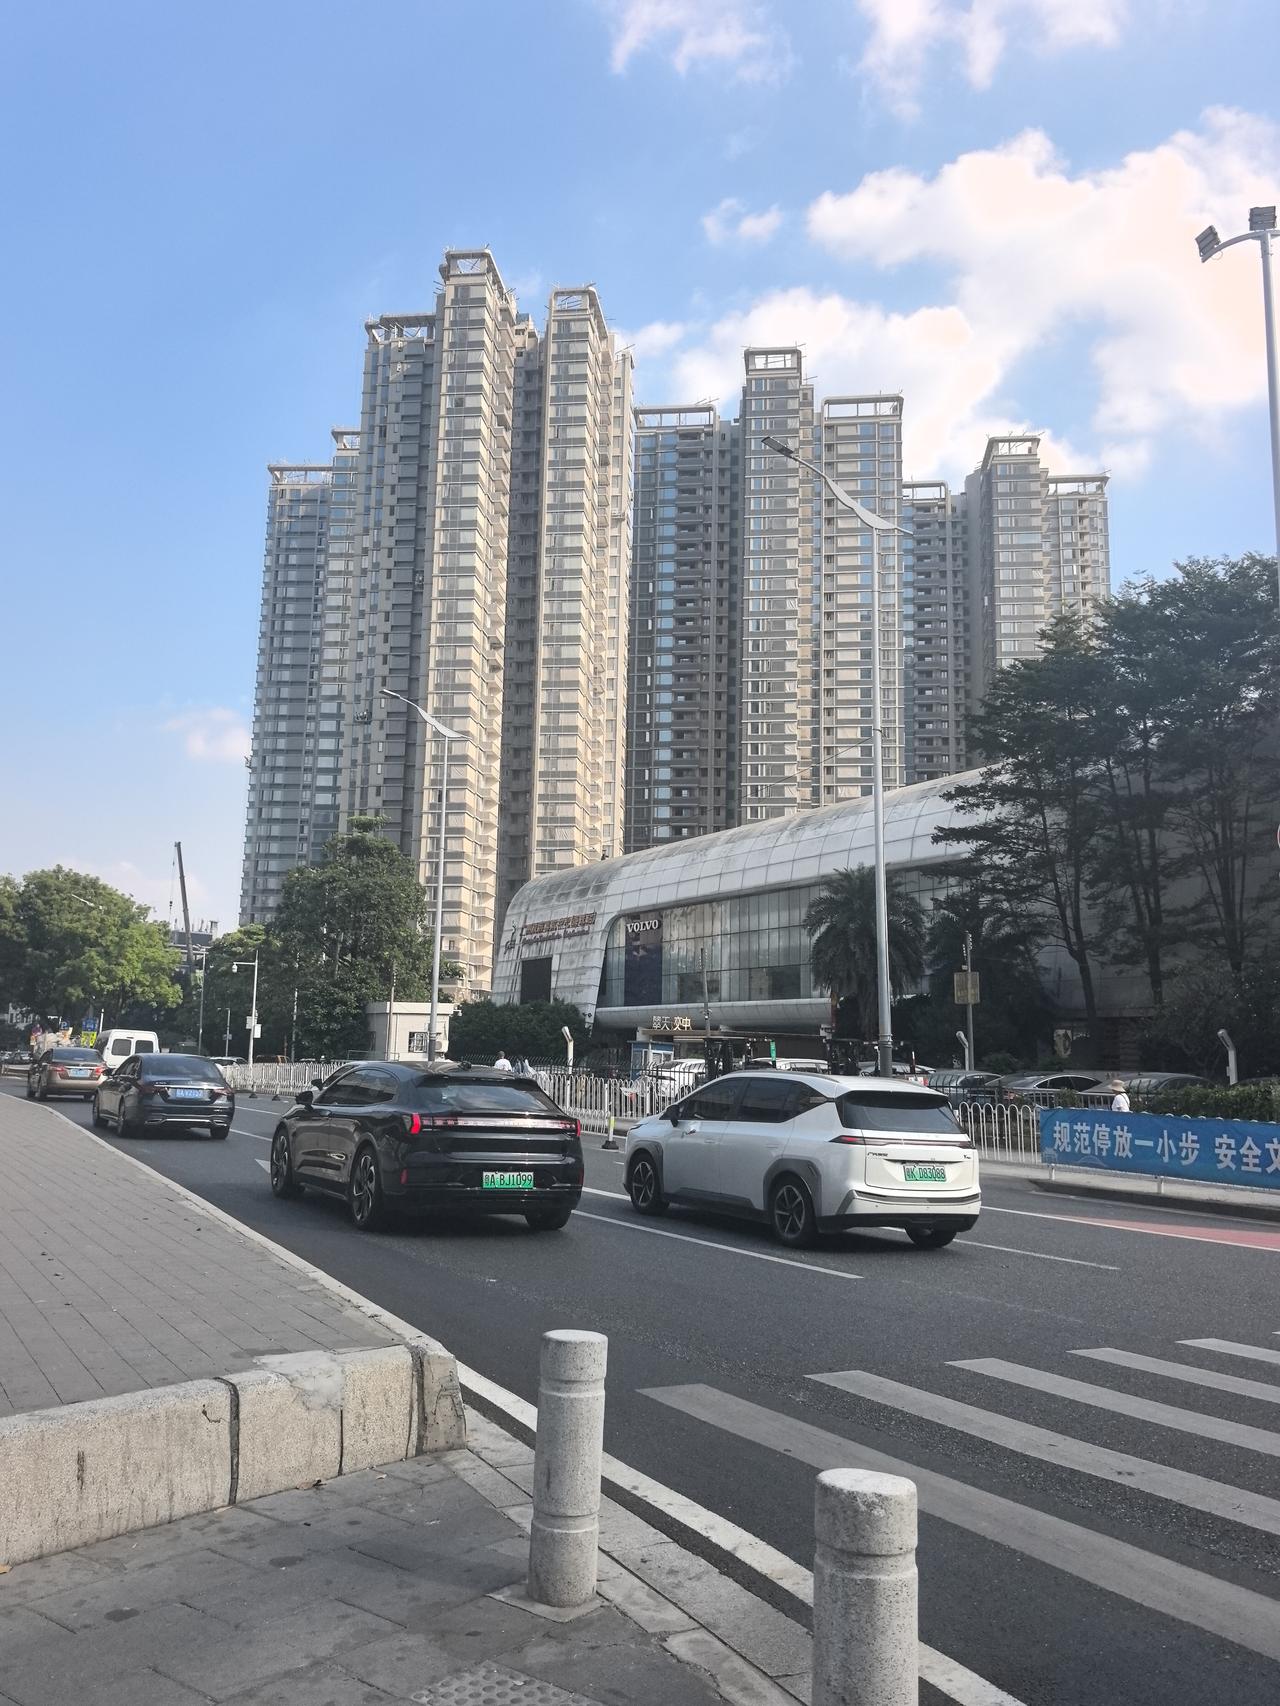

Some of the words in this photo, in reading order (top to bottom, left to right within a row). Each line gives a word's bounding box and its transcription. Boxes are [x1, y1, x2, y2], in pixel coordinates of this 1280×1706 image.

[626, 919, 660, 933] VOLVO
[1053, 1120, 1200, 1166] 规范停放一小步
